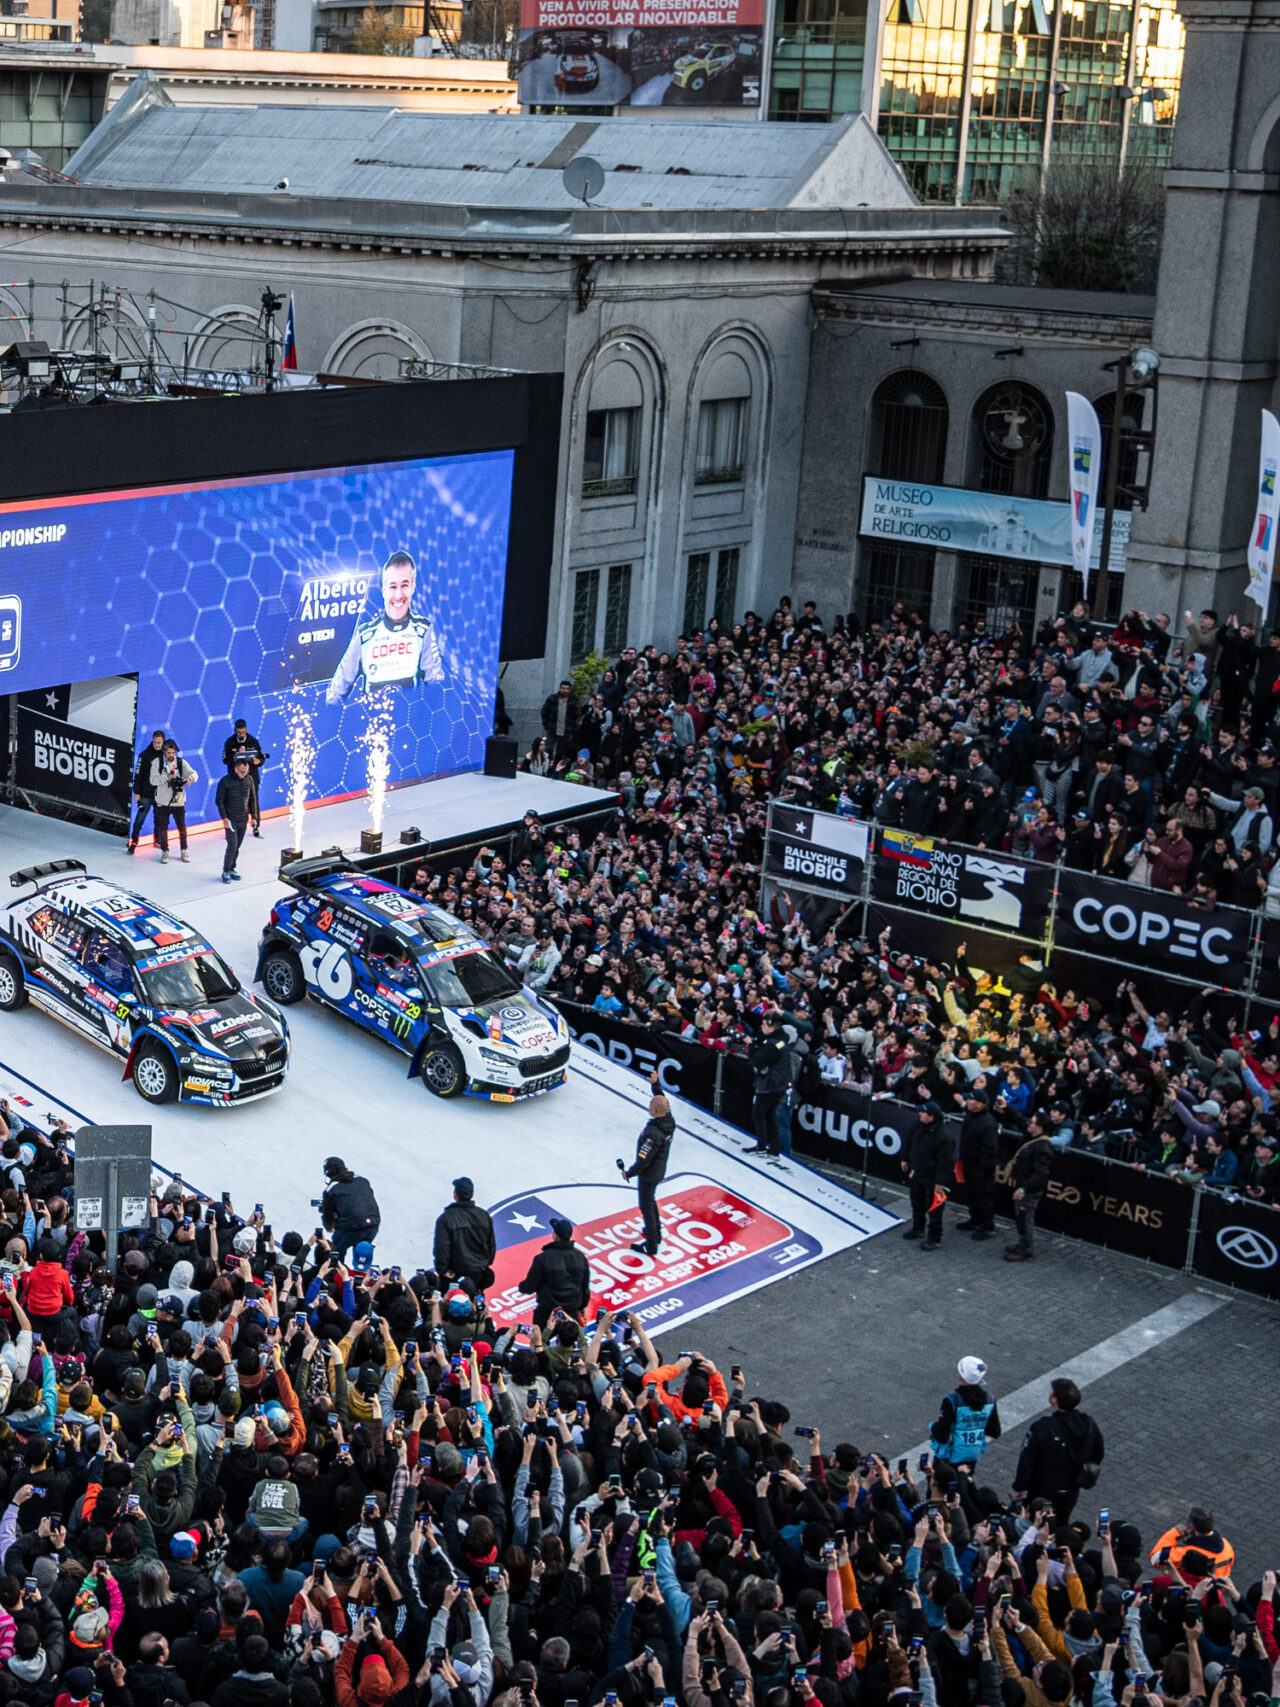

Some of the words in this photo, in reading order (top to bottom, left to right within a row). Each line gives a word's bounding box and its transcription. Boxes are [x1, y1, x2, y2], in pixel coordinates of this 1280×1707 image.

[539, 0, 564, 12] VEN
[565, 0, 576, 12] A
[578, 0, 609, 11] VIVIR
[612, 0, 640, 10] UNA
[539, 12, 634, 26] PROTOCOLAR
[639, 11, 737, 25] INOLVIDABLE
[876, 484, 934, 506] MUSEO
[873, 504, 886, 514] DE
[888, 506, 914, 518] ARTE
[872, 517, 951, 542] RELIGIOSO
[300, 577, 368, 602] Alberto
[298, 631, 312, 644] CB
[312, 628, 335, 642] TECH
[372, 642, 413, 658] COPEC
[34, 729, 116, 764] RALLYCHILE
[784, 846, 848, 869] RALLYCHILE
[896, 880, 958, 908] BIOBIO
[940, 877, 958, 892] DEL
[84, 914, 122, 939] KOVACS
[316, 910, 333, 932] 29
[1072, 896, 1234, 964] COPEC
[155, 940, 190, 955] KOVACS
[35, 966, 70, 994] ACDelco
[116, 1003, 130, 1020] 37
[354, 988, 391, 1022] COPEC
[406, 1002, 421, 1020] 29
[210, 1012, 262, 1034] ACDelco
[148, 1022, 181, 1048] KOVACS
[522, 1031, 557, 1050] COPEC
[188, 1076, 230, 1089] KOVACS
[1089, 1190, 1164, 1230] YEARS
[603, 1288, 634, 1306] 26
[635, 1273, 664, 1292] 29
[658, 1260, 702, 1287] SEPT
[699, 1241, 747, 1268] 2024
